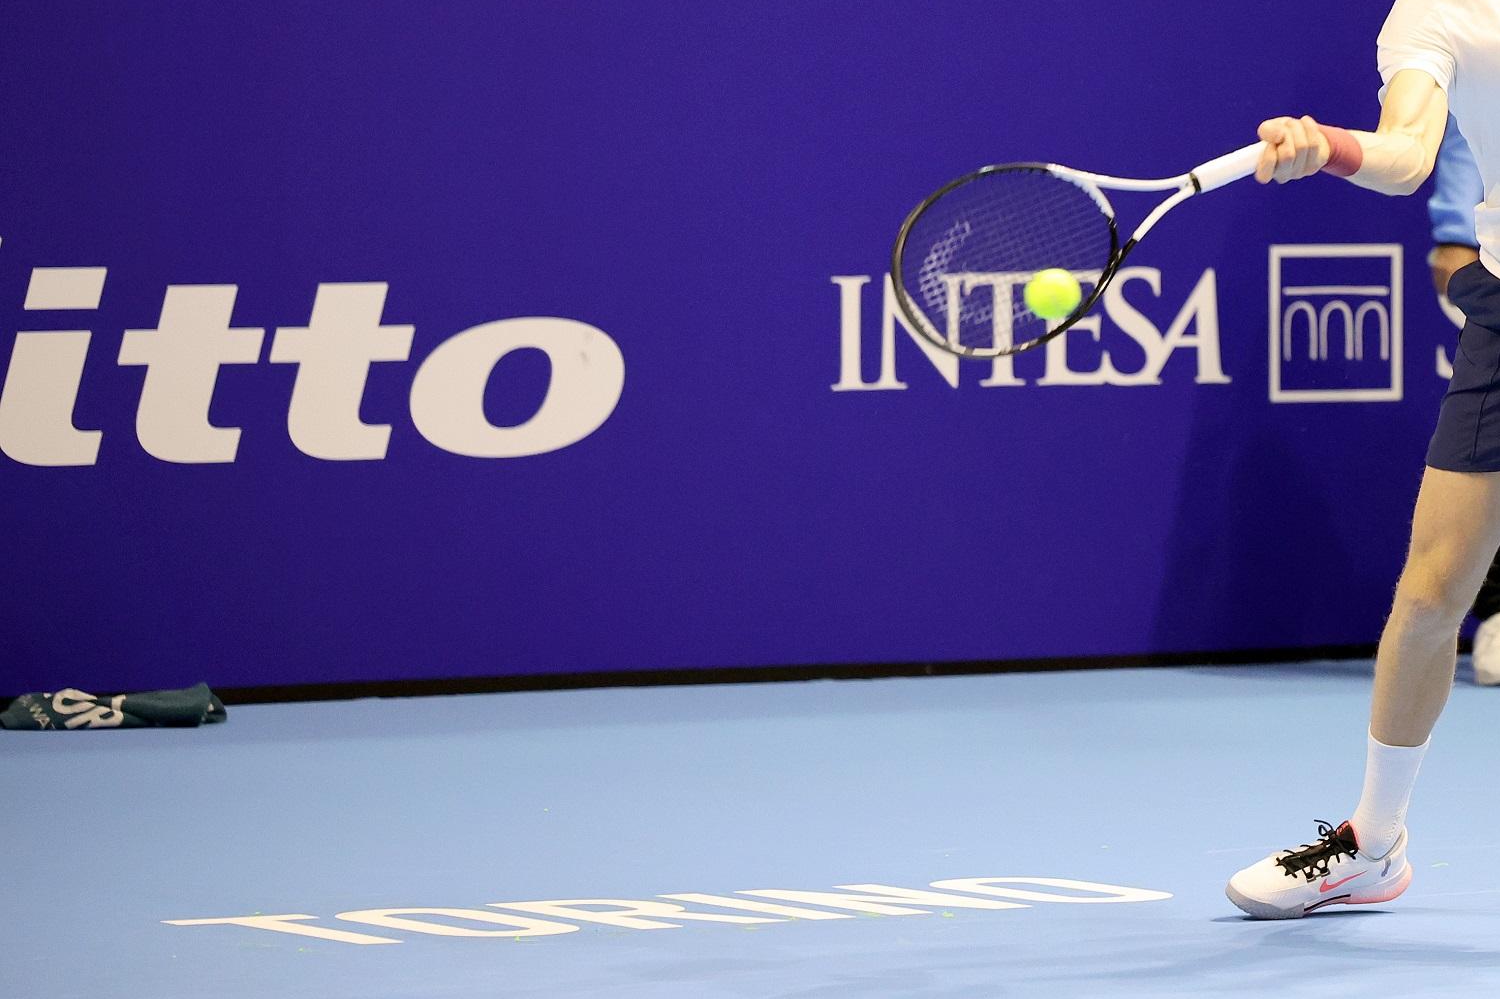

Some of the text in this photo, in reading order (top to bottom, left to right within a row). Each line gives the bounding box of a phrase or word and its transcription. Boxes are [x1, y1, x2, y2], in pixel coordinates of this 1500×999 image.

[0, 264, 627, 467] itto
[830, 266, 1233, 392] INTESA
[160, 876, 1174, 945] TORINO
